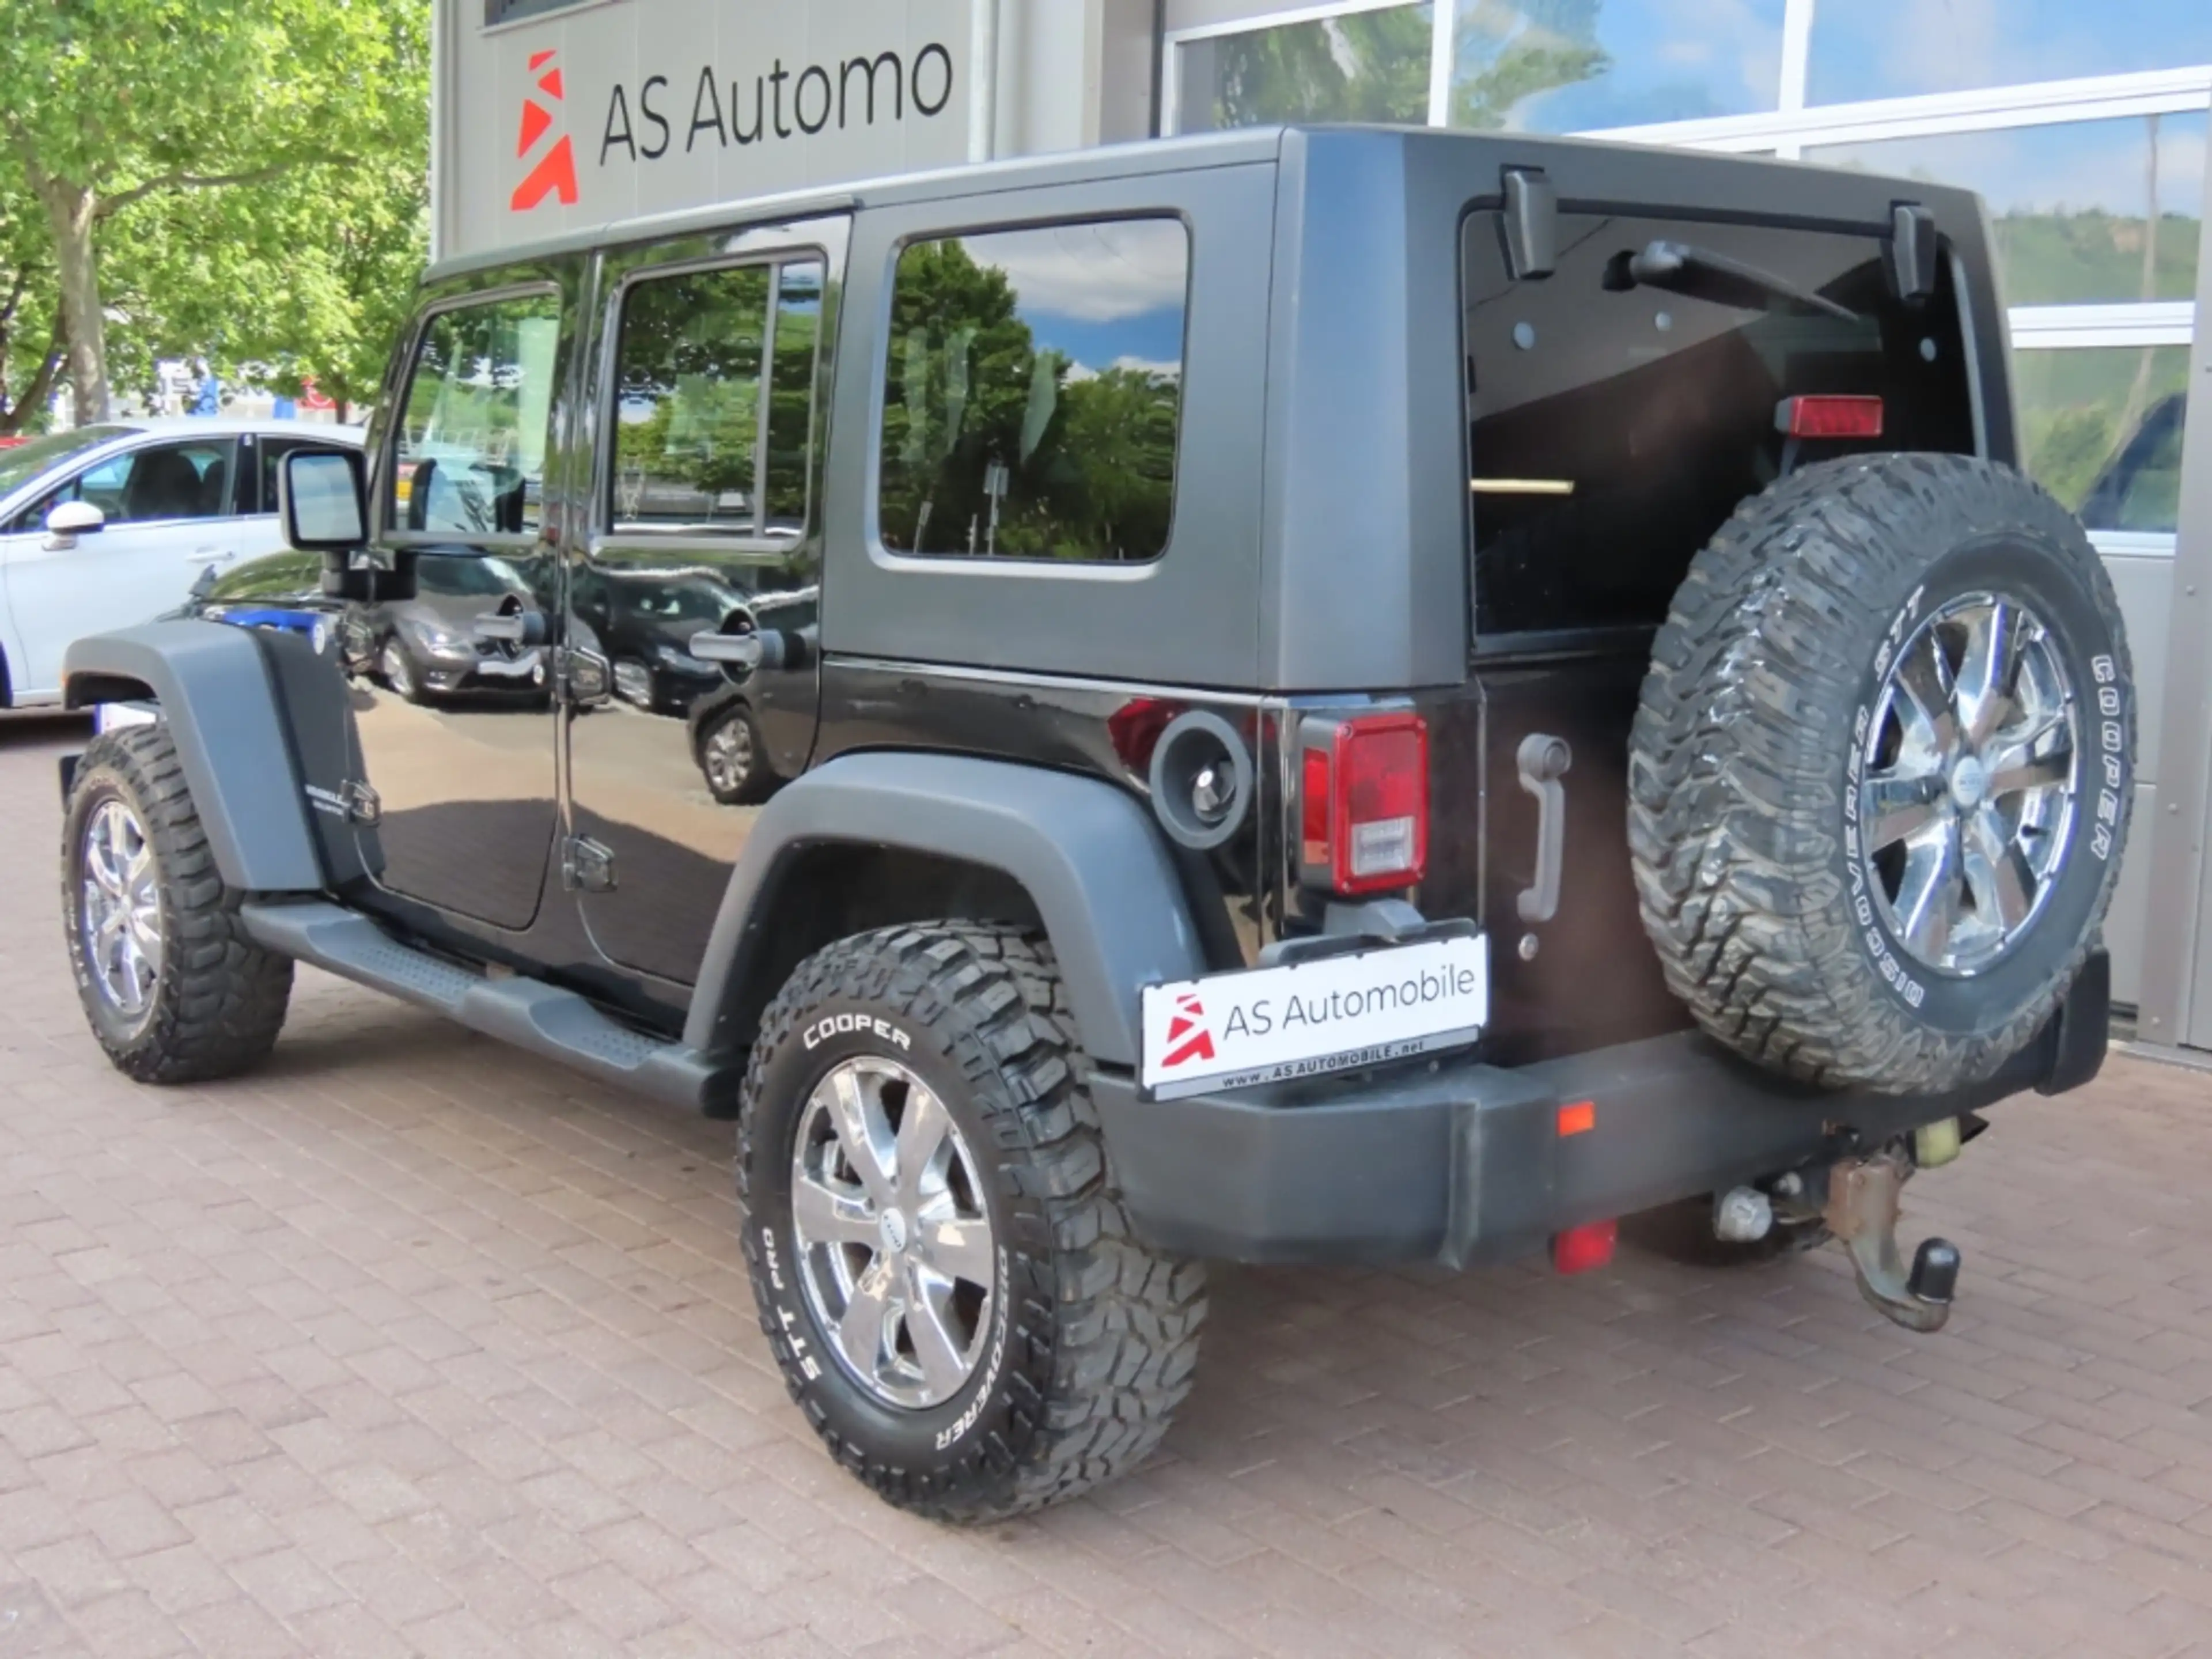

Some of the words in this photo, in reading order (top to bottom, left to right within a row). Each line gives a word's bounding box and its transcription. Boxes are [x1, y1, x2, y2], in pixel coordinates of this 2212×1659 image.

[600, 75, 671, 166] AS
[685, 43, 952, 152] Automo
[1874, 585, 1925, 681] STT
[2091, 654, 2122, 861] COOPER
[1846, 705, 1924, 1008] DISCOVERER
[803, 1012, 911, 1051] COOPER
[1224, 1000, 1273, 1040] AS
[1282, 964, 1475, 1029] Automobile
[762, 1226, 785, 1290] PRO
[777, 1304, 823, 1380] STT
[936, 1244, 1009, 1450] DISCOVERER
